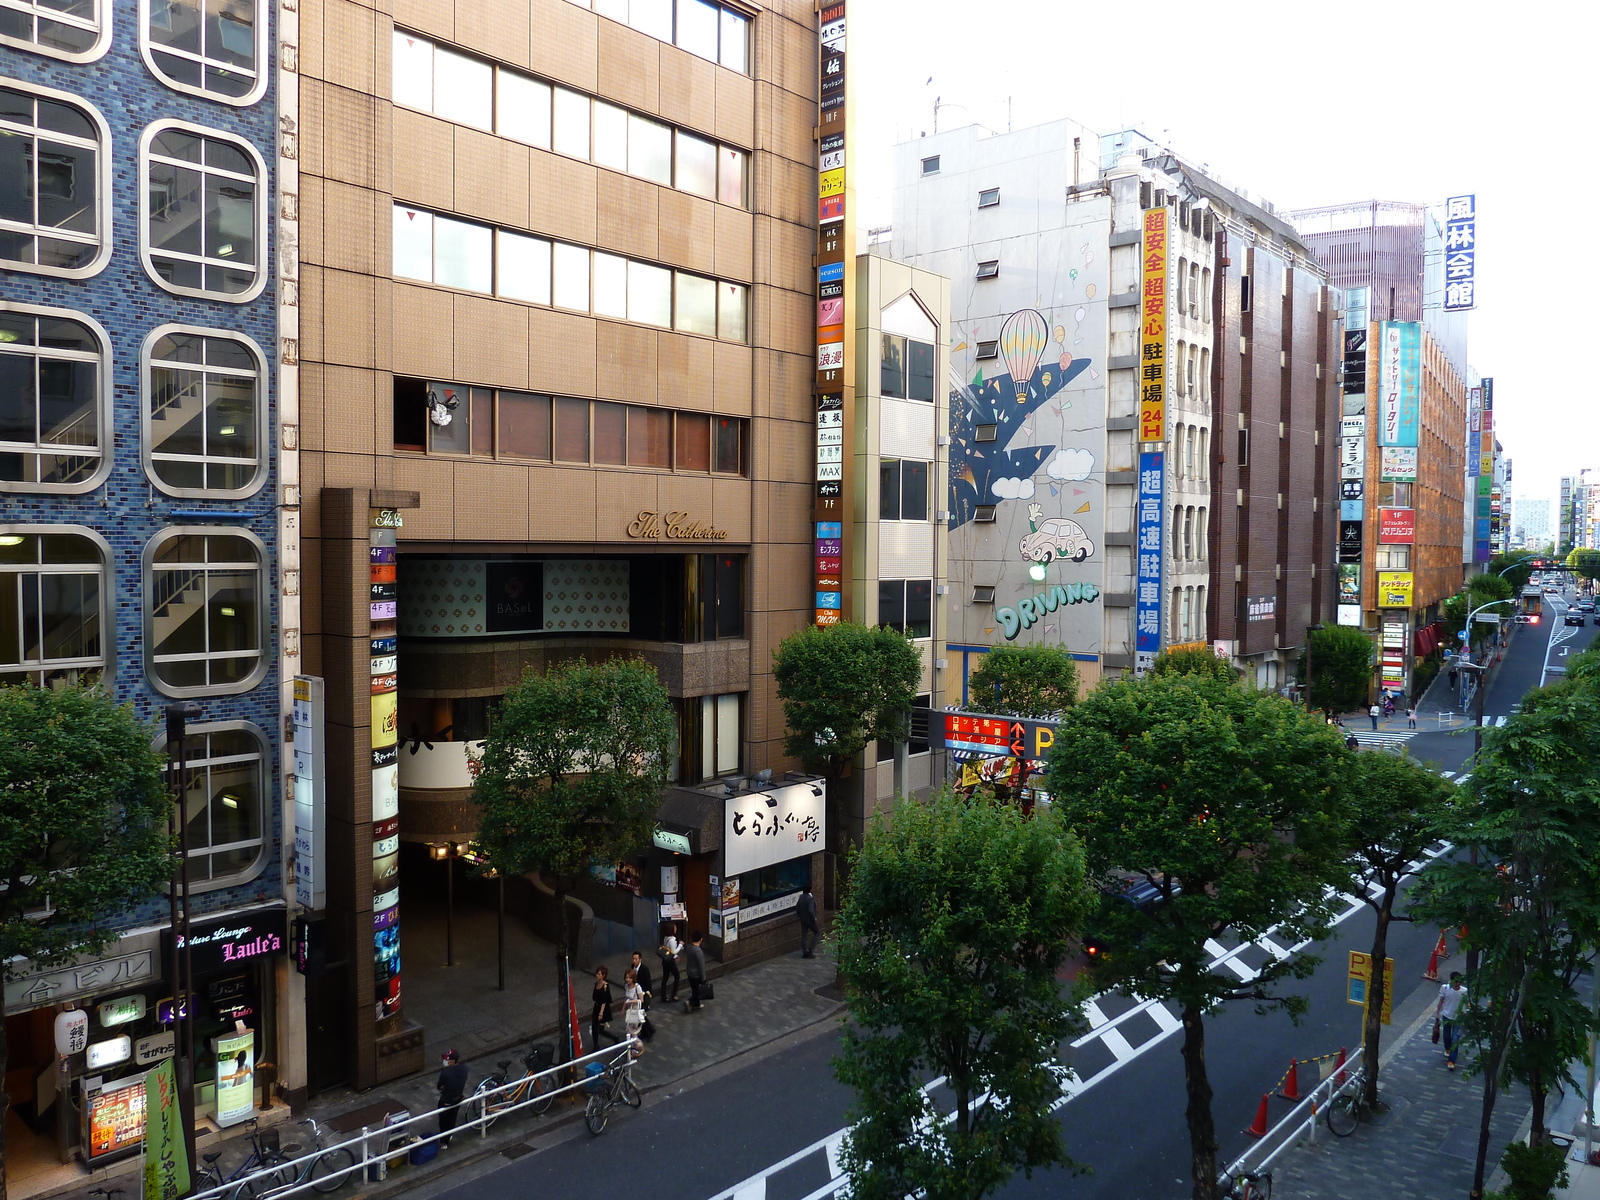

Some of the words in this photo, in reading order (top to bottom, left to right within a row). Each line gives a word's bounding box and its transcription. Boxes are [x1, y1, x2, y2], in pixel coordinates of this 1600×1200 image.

[821, 180, 842, 193] カリーナ
[1145, 212, 1164, 272] 超安全
[1445, 196, 1474, 306] 風林会館
[1144, 277, 1163, 337] 超安心
[819, 351, 842, 366] 浪漫
[1142, 342, 1162, 403] 駐車場
[820, 467, 840, 476] MAX
[627, 510, 662, 538] The
[371, 548, 382, 557] 4F
[820, 546, 840, 554] モンブラン
[1138, 470, 1161, 635] 超高速駐車場
[371, 568, 382, 576] 4F
[372, 585, 383, 594] 4F
[372, 603, 383, 612] 4F
[996, 581, 1099, 640] DRIVING
[372, 641, 383, 650] 4F
[372, 660, 383, 669] 4F
[372, 679, 383, 688] 4F
[952, 716, 1002, 728] ロッテ第一
[952, 724, 1001, 737] 尾張屋
[952, 732, 1001, 745] ハイジア
[1035, 726, 1055, 757] P
[374, 897, 385, 905] 2F
[374, 915, 386, 926] 2F
[212, 926, 250, 940] Lounge
[1351, 954, 1365, 969] P
[140, 1043, 175, 1059] すがわら
